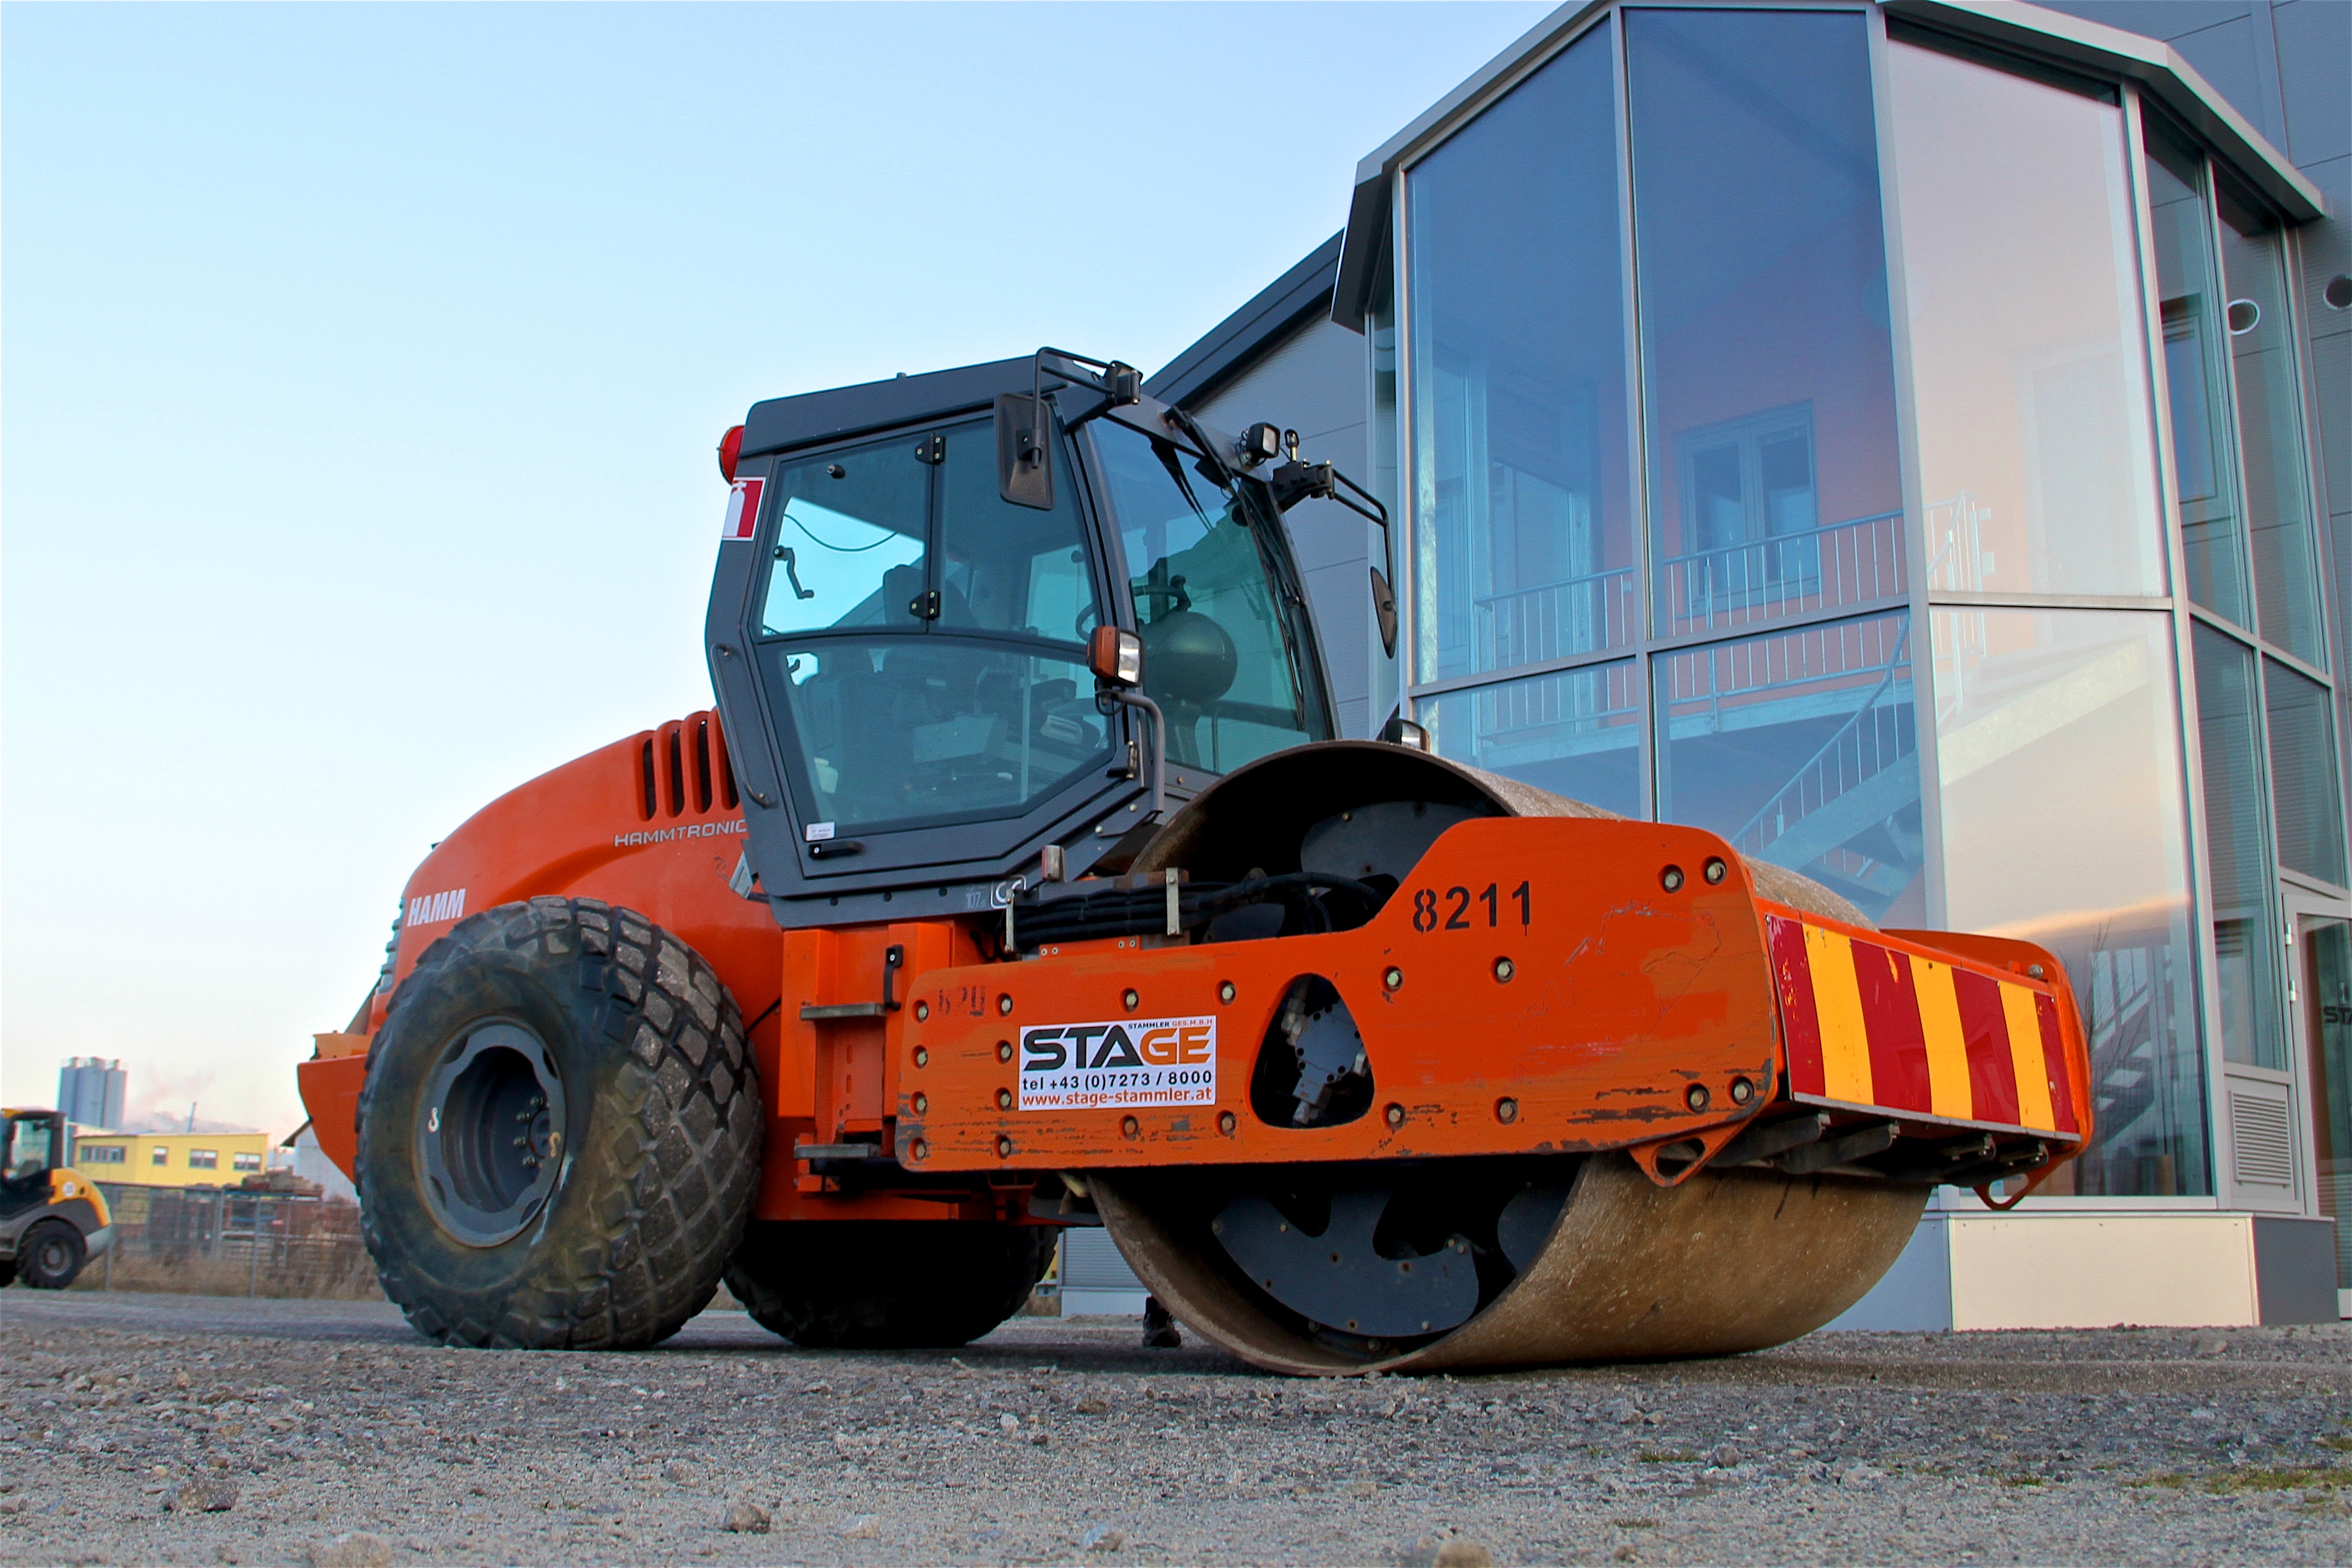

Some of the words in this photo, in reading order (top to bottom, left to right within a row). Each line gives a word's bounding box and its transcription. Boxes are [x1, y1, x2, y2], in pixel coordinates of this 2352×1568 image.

[614, 819, 747, 847] HAMMTRONIC
[407, 888, 467, 927] HAMM
[1412, 880, 1530, 934] 8211
[1024, 1024, 1211, 1072] STAGE
[1023, 1076, 1044, 1090] tel
[1050, 1076, 1079, 1089] +43
[1168, 1070, 1212, 1085] 8000
[1023, 1087, 1212, 1107] www.stage-stammler.at
